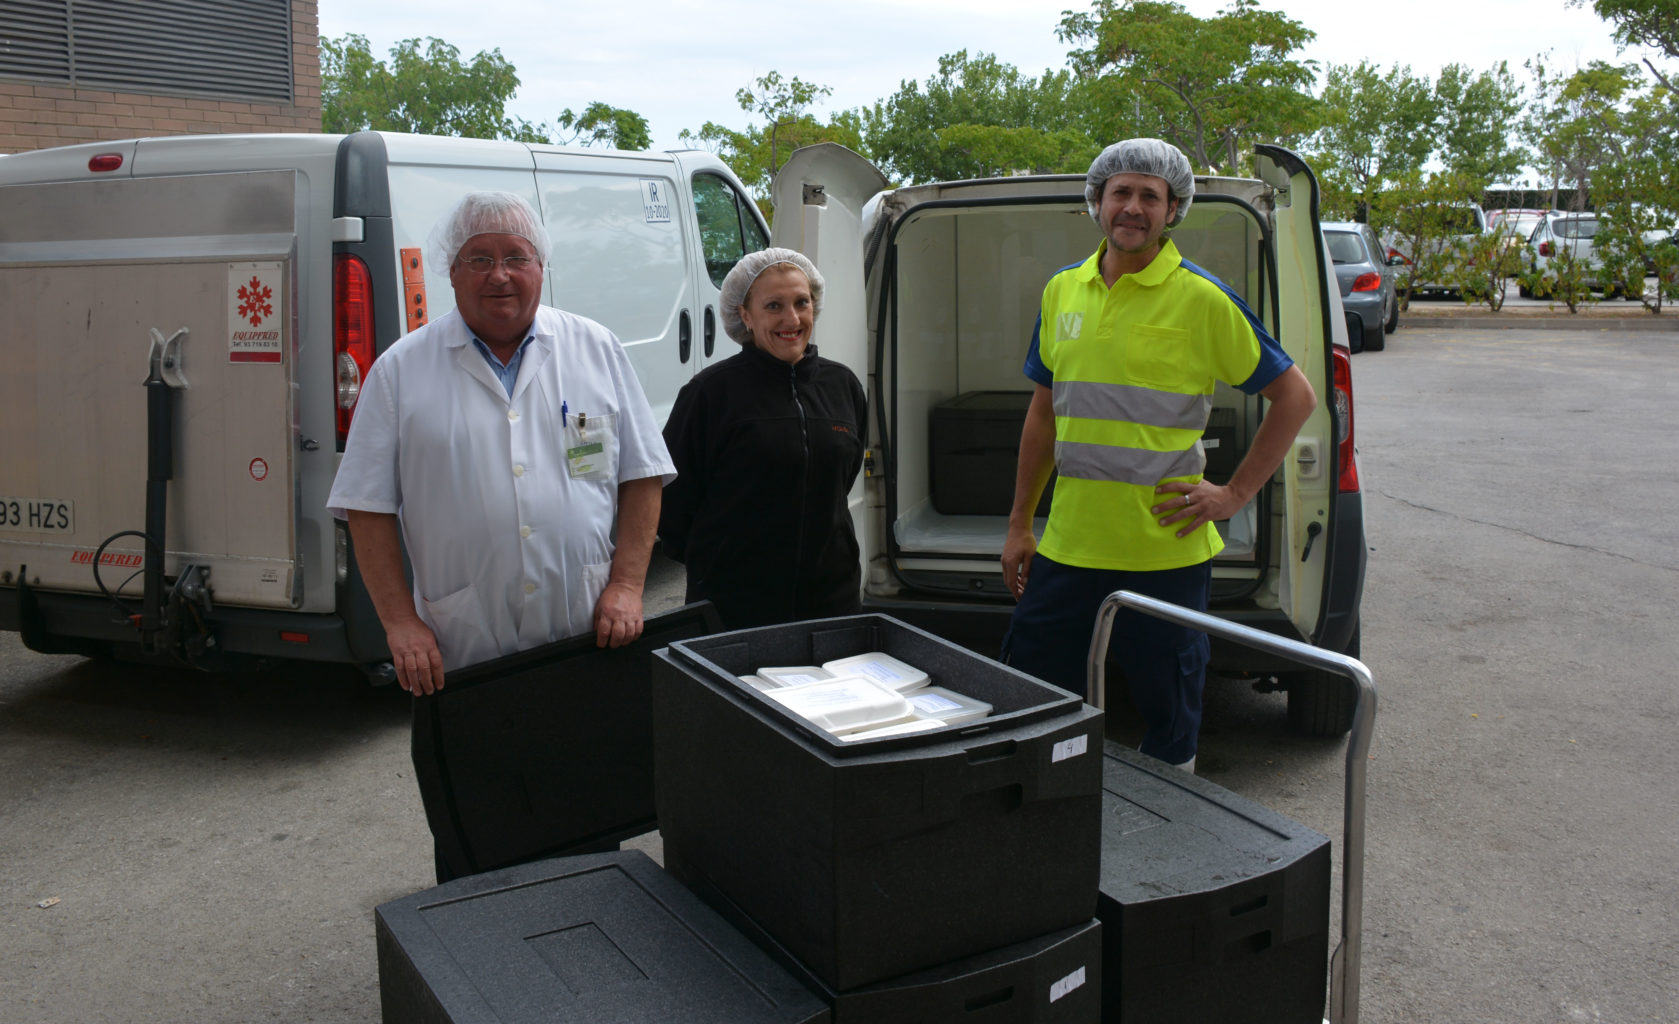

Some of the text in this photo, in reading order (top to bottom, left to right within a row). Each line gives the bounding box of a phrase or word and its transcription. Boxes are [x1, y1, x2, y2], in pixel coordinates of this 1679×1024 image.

[648, 182, 660, 202] IR
[645, 205, 669, 219] 10-2020
[28, 502, 69, 529] HZS
[71, 550, 143, 567] EQUPFRED
